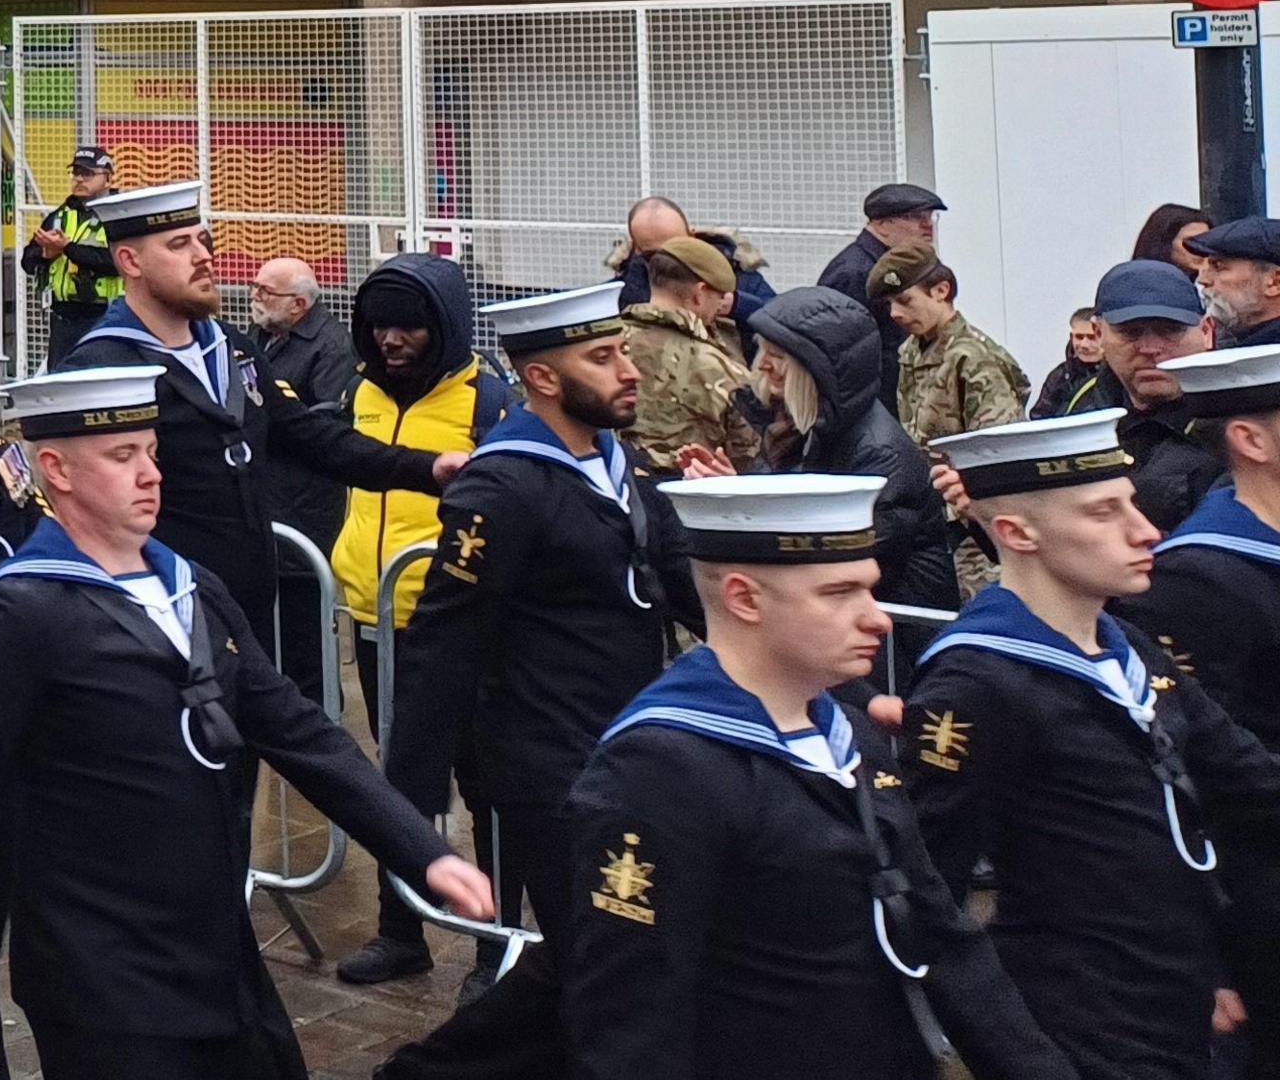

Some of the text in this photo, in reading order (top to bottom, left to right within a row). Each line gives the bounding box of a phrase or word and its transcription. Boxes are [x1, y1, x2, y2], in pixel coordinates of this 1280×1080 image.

[1211, 13, 1249, 22] Permit
[1210, 23, 1253, 33] holders
[1220, 34, 1245, 43] only
